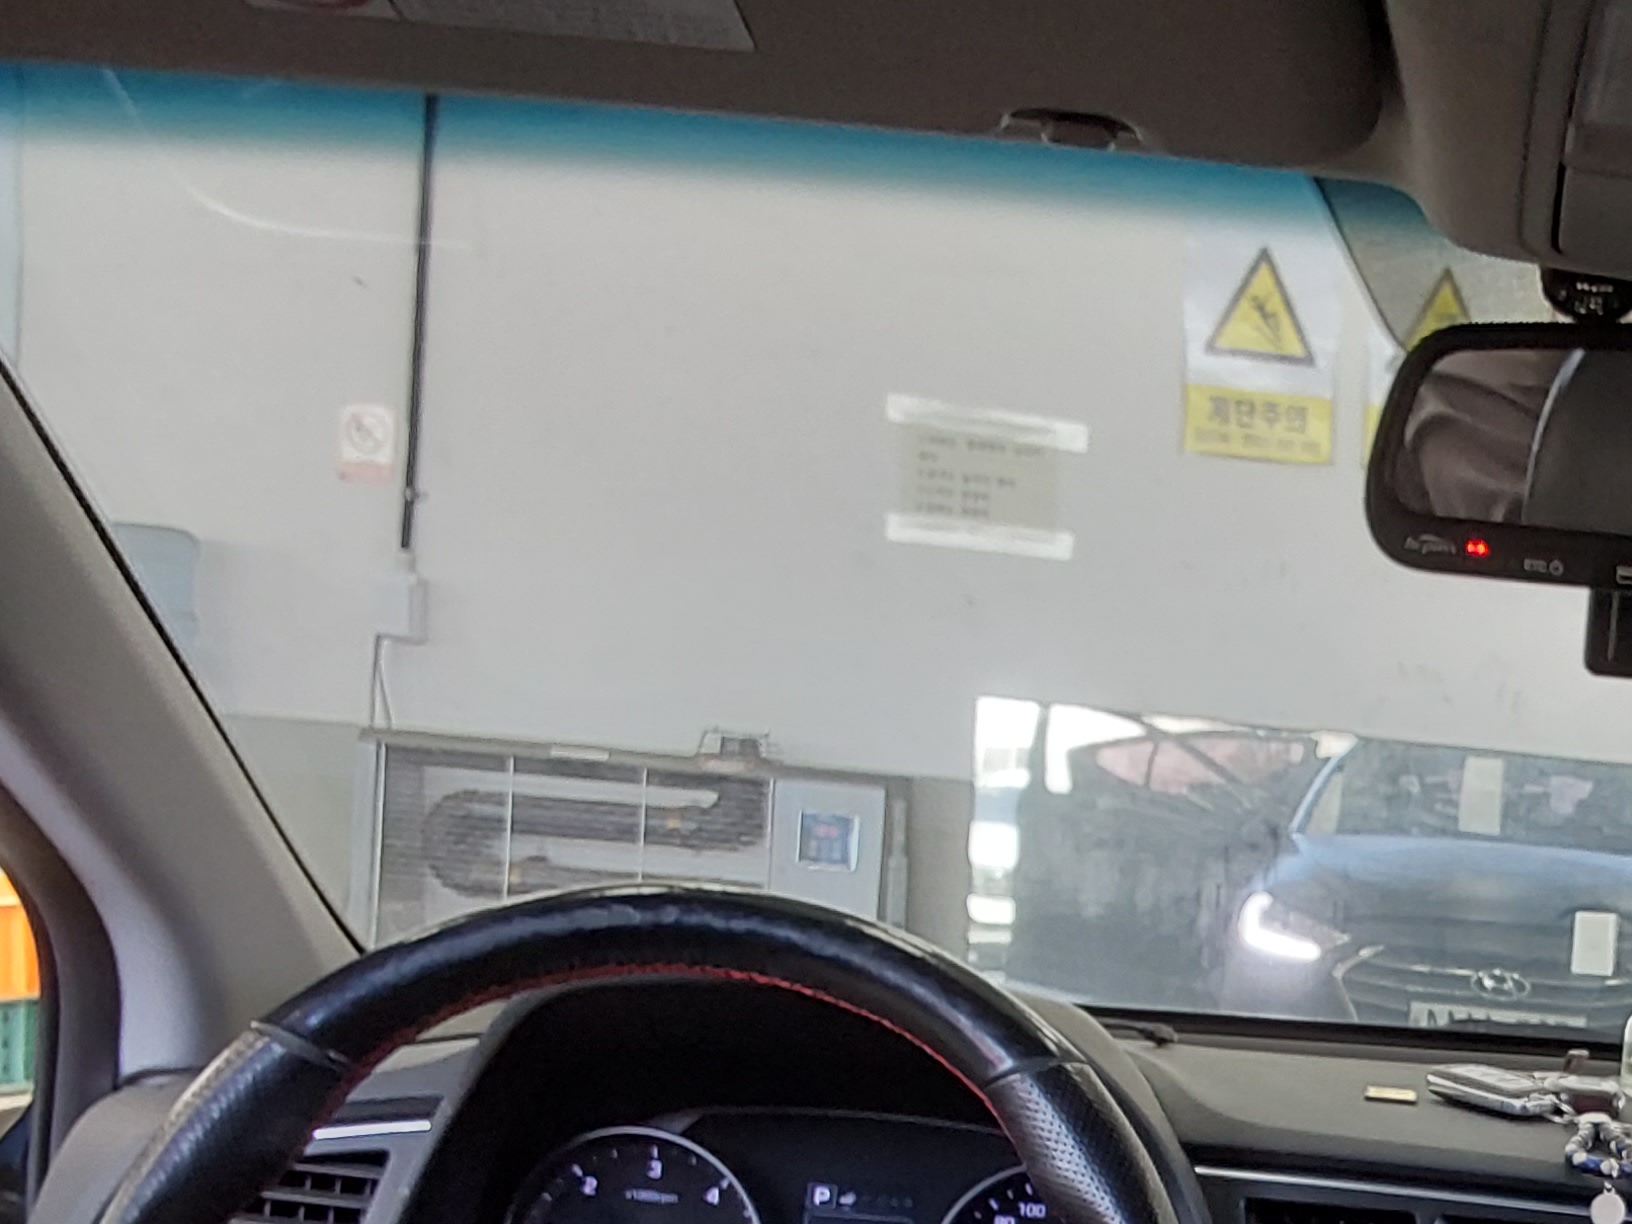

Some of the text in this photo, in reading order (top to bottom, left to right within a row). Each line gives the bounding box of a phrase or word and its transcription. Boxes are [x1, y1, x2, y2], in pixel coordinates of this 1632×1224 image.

[648, 1158, 663, 1180] 3
[580, 1175, 598, 1196] 2
[702, 1185, 720, 1206] 4
[812, 1185, 831, 1206] P
[1018, 1201, 1046, 1218] 100
